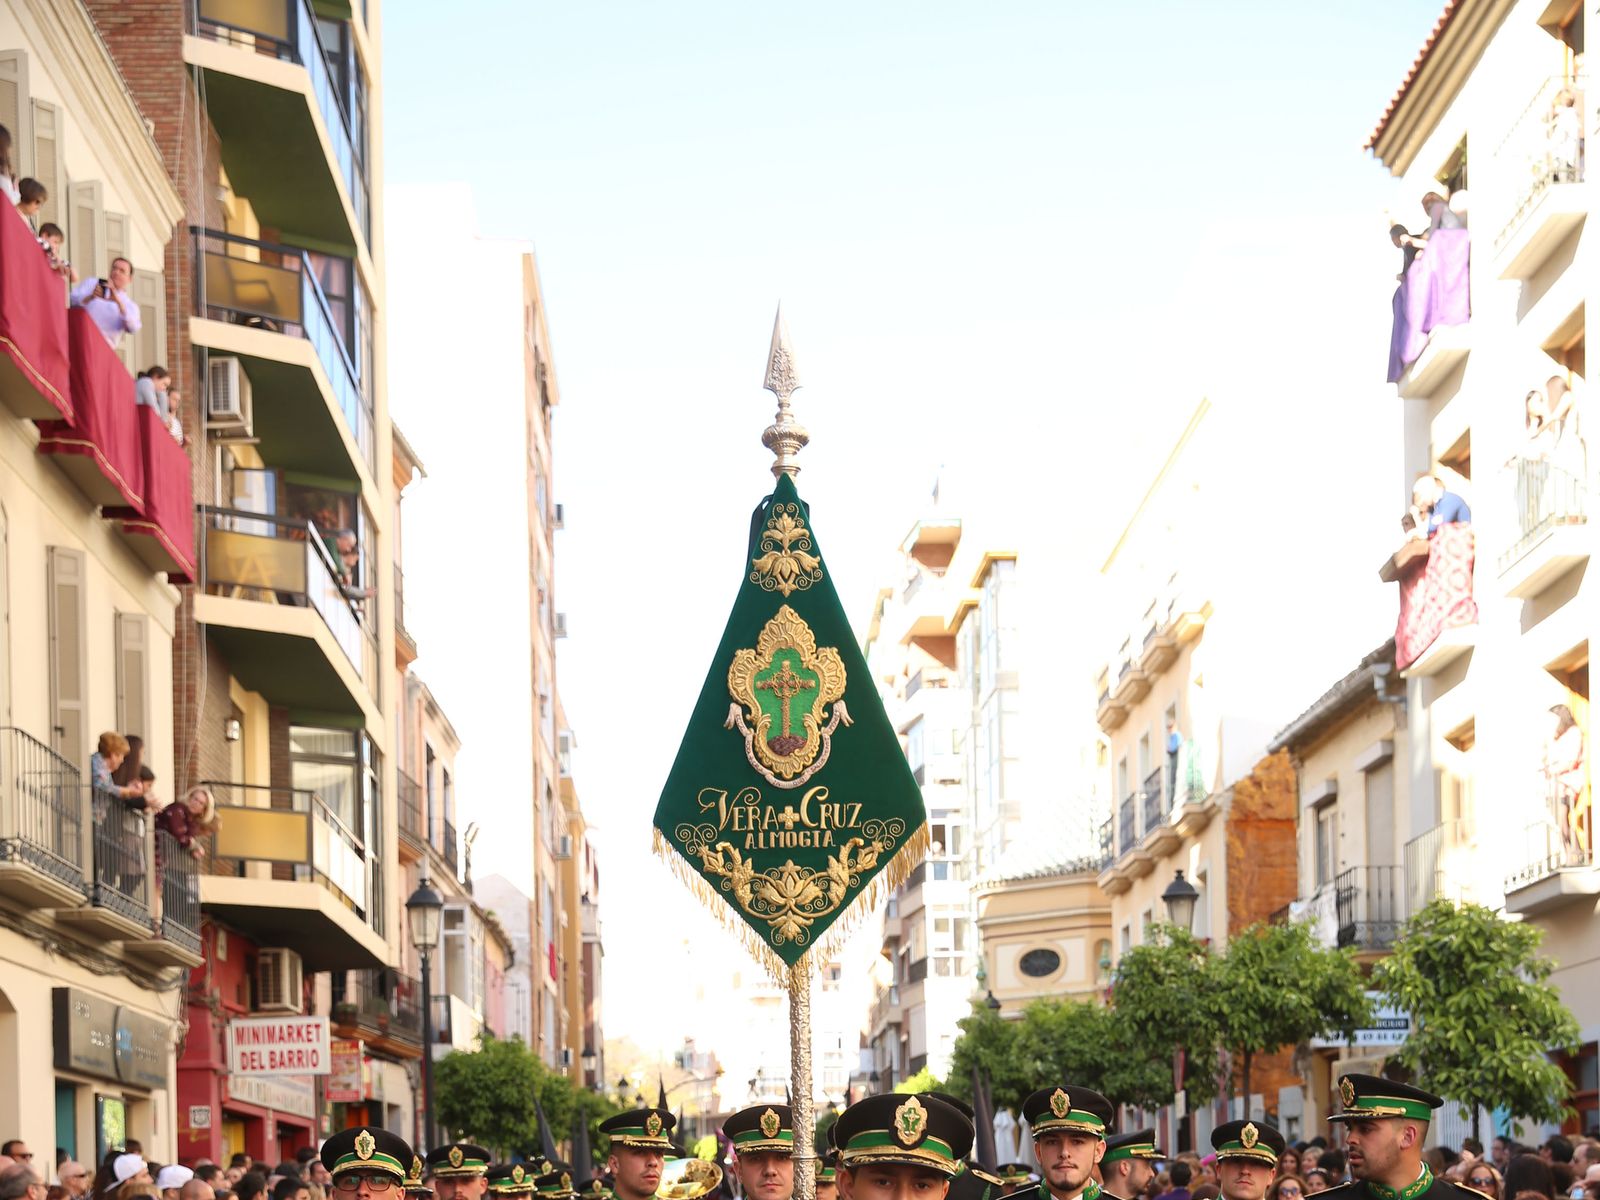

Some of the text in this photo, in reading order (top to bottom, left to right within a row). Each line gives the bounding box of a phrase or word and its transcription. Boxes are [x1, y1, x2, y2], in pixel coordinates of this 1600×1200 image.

[698, 786, 862, 832] VERA CRUZ
[744, 830, 836, 849] ALMOGIA
[235, 1023, 321, 1045] MINIMARKET
[241, 1049, 319, 1071] DEL BARRIO
